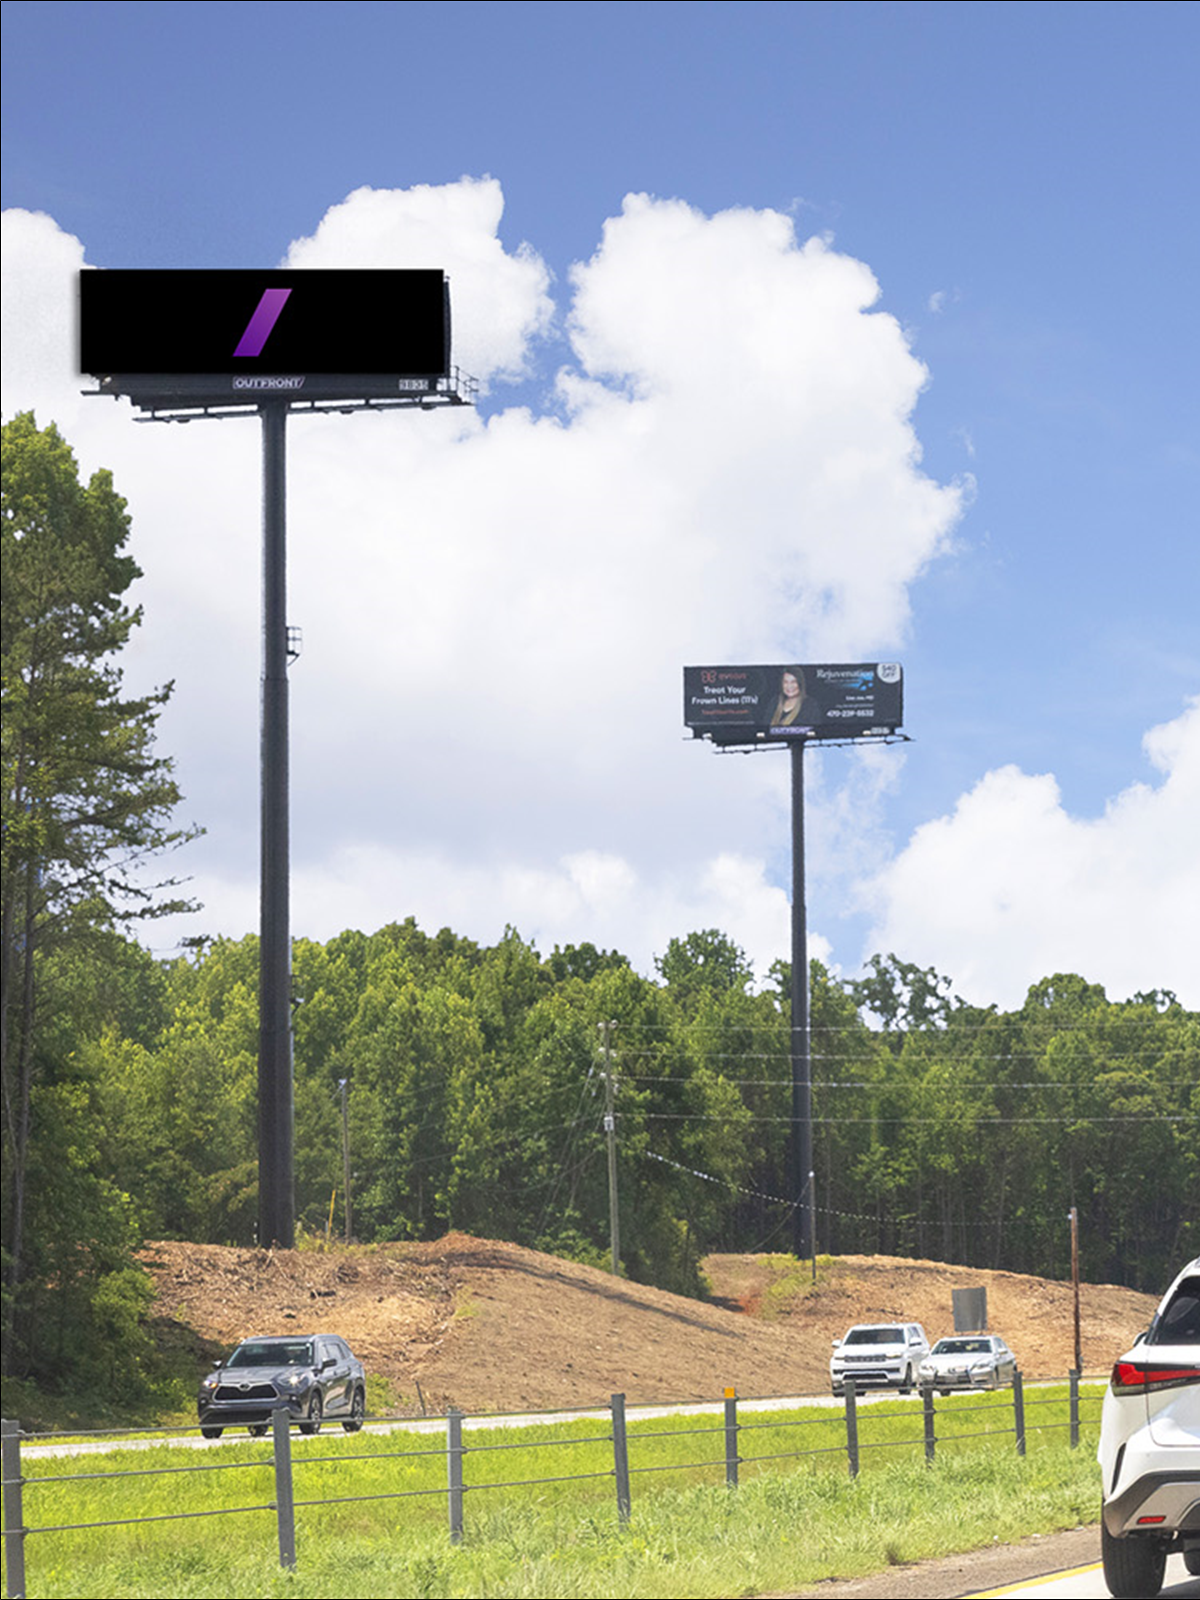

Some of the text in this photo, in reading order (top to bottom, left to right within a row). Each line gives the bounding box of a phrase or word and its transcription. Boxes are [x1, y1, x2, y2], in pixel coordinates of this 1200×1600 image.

[235, 377, 302, 388] OUTFRONT
[703, 685, 746, 694] Treat Your
[691, 697, 717, 705] Frown
[718, 696, 739, 704] Lines
